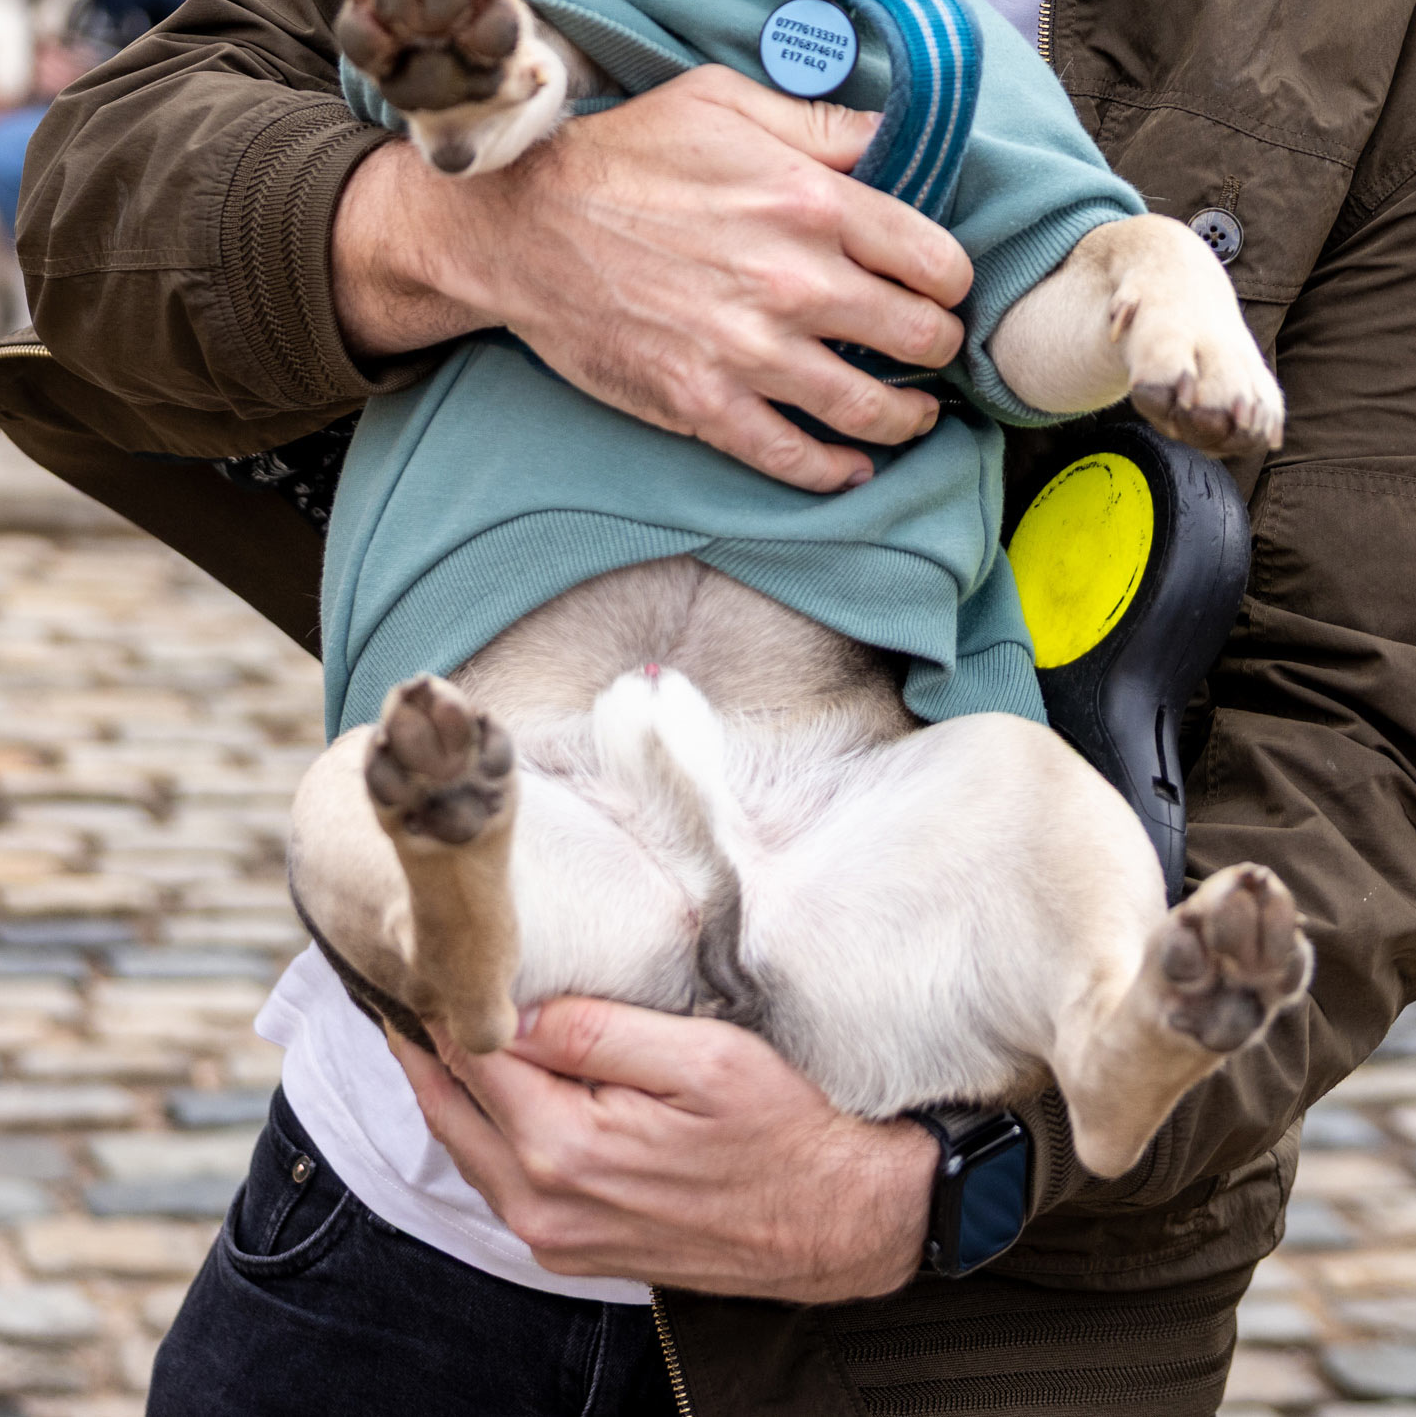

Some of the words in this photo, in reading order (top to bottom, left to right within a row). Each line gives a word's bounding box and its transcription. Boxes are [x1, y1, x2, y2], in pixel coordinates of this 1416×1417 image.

[771, 31, 845, 61] 07476874616
[776, 17, 849, 47] 07776133313
[781, 48, 802, 62] E17
